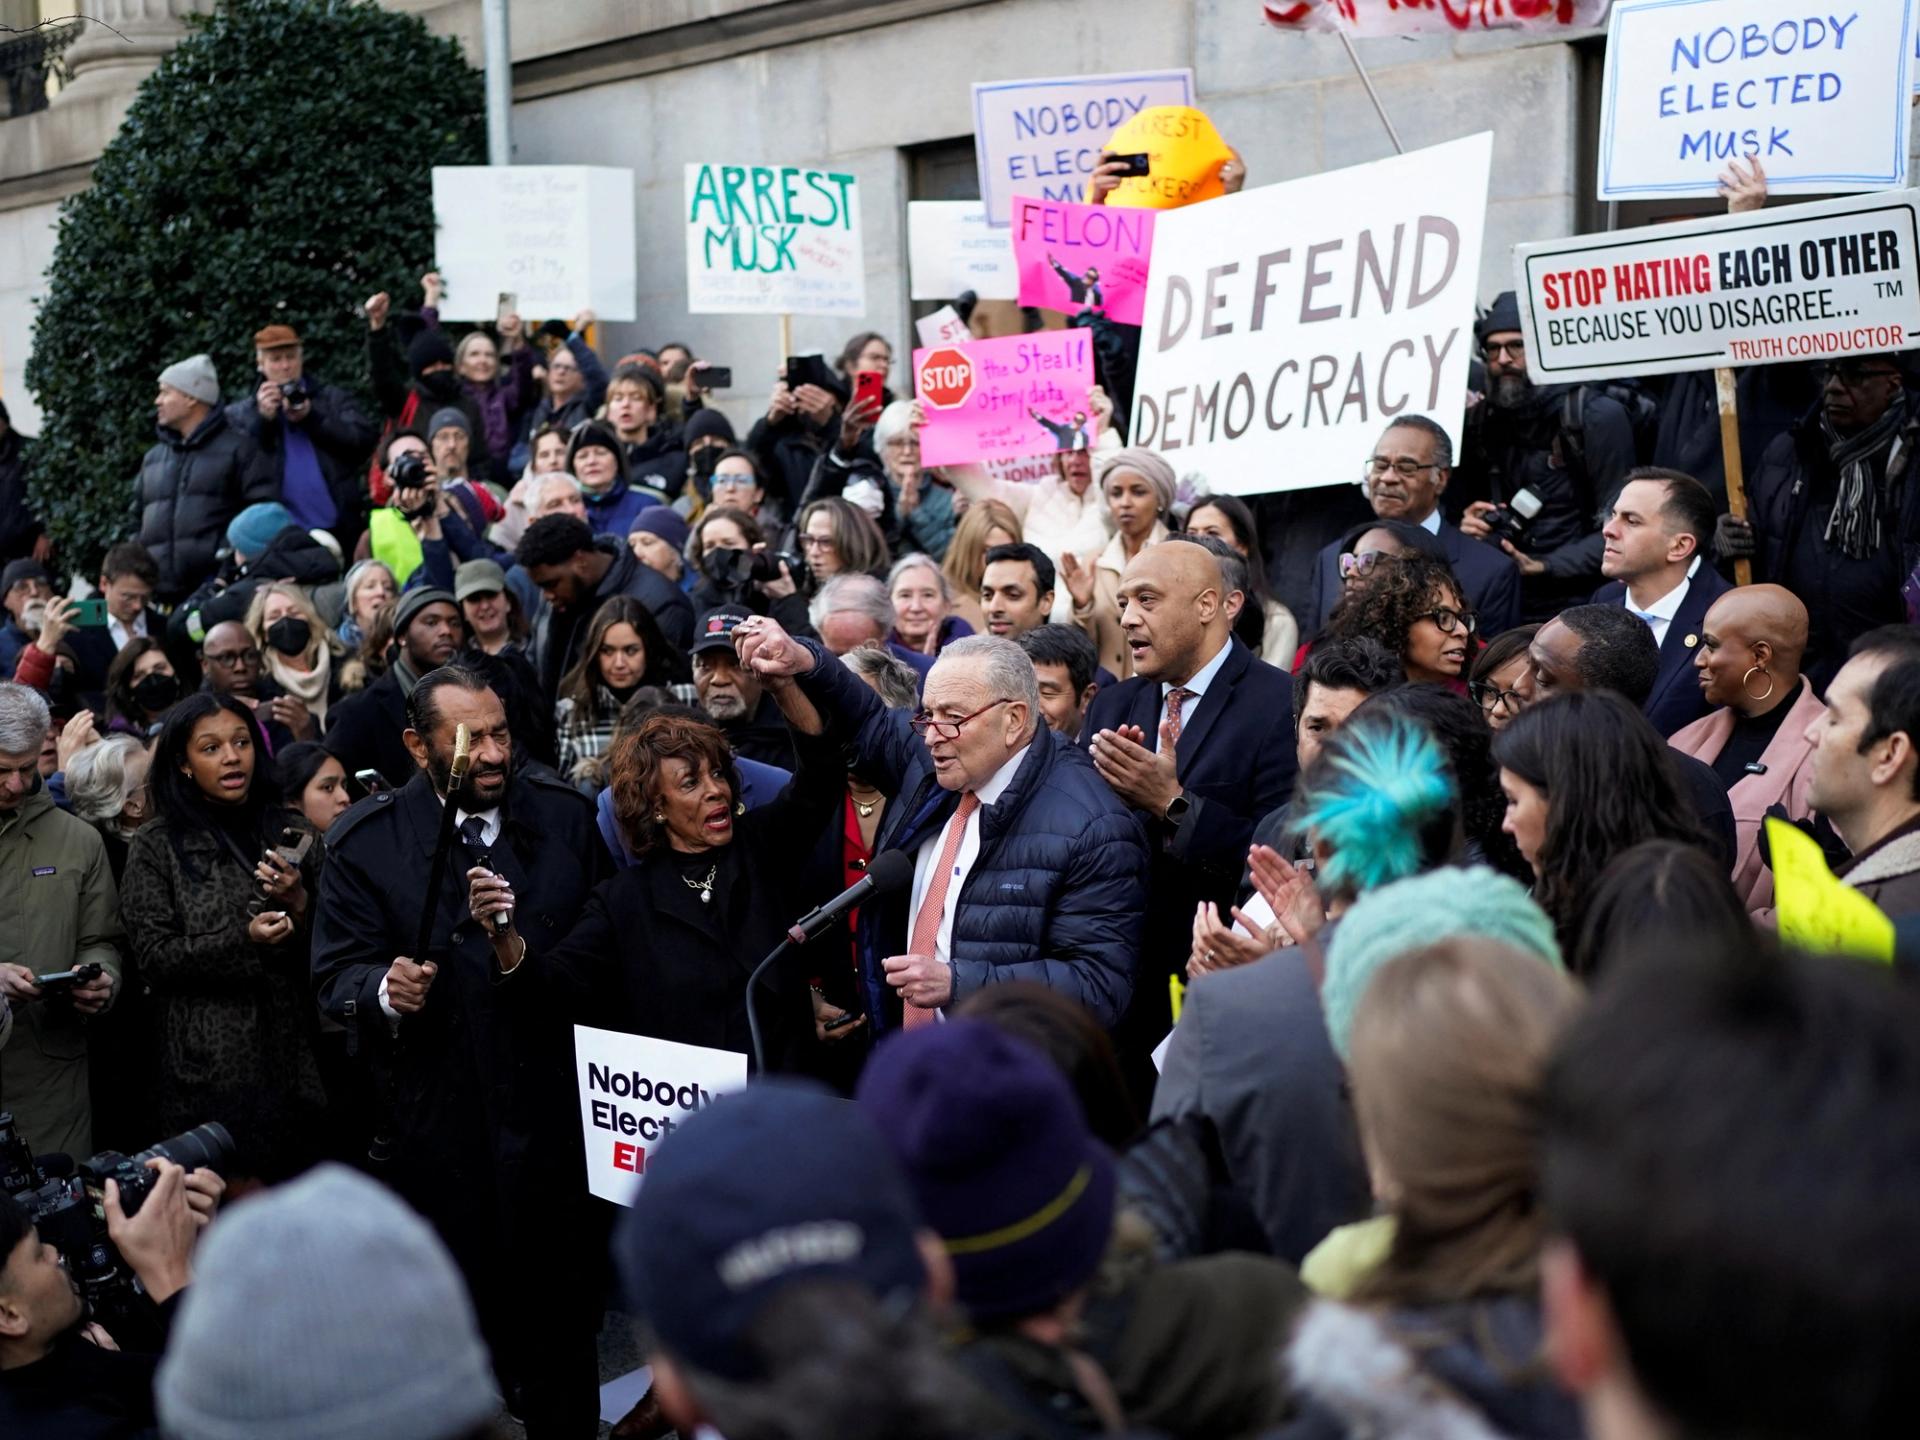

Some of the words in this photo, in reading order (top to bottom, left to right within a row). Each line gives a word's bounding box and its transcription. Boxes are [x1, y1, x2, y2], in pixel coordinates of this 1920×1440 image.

[1671, 13, 1859, 75] NOBODY
[1659, 72, 1842, 118] ELECTED
[1008, 148, 1104, 180] ELEC
[1680, 126, 1793, 162] MUSK
[690, 165, 855, 231] ARREST
[705, 225, 797, 273] MUSK
[1021, 204, 1143, 254] FELON
[1157, 215, 1460, 353] DEFEND
[1542, 268, 1607, 311] STOP
[1613, 253, 1712, 303] HATING
[1718, 243, 1792, 291] EACH
[1800, 229, 1900, 281] OTHER
[1873, 280, 1903, 300] TM
[1548, 310, 1650, 347] BECAUSE
[1655, 304, 1702, 336] YOU
[1711, 289, 1859, 331] DISAGREE...
[1014, 339, 1084, 374] Steal!
[1729, 336, 1783, 361] TRUTH
[1787, 325, 1903, 356] CONDUCTOR
[922, 364, 971, 392] STOP
[1134, 327, 1460, 451] DEMOCRACY
[588, 1062, 723, 1112] Nobody
[591, 1099, 678, 1141] Elect
[613, 1141, 646, 1175] El
